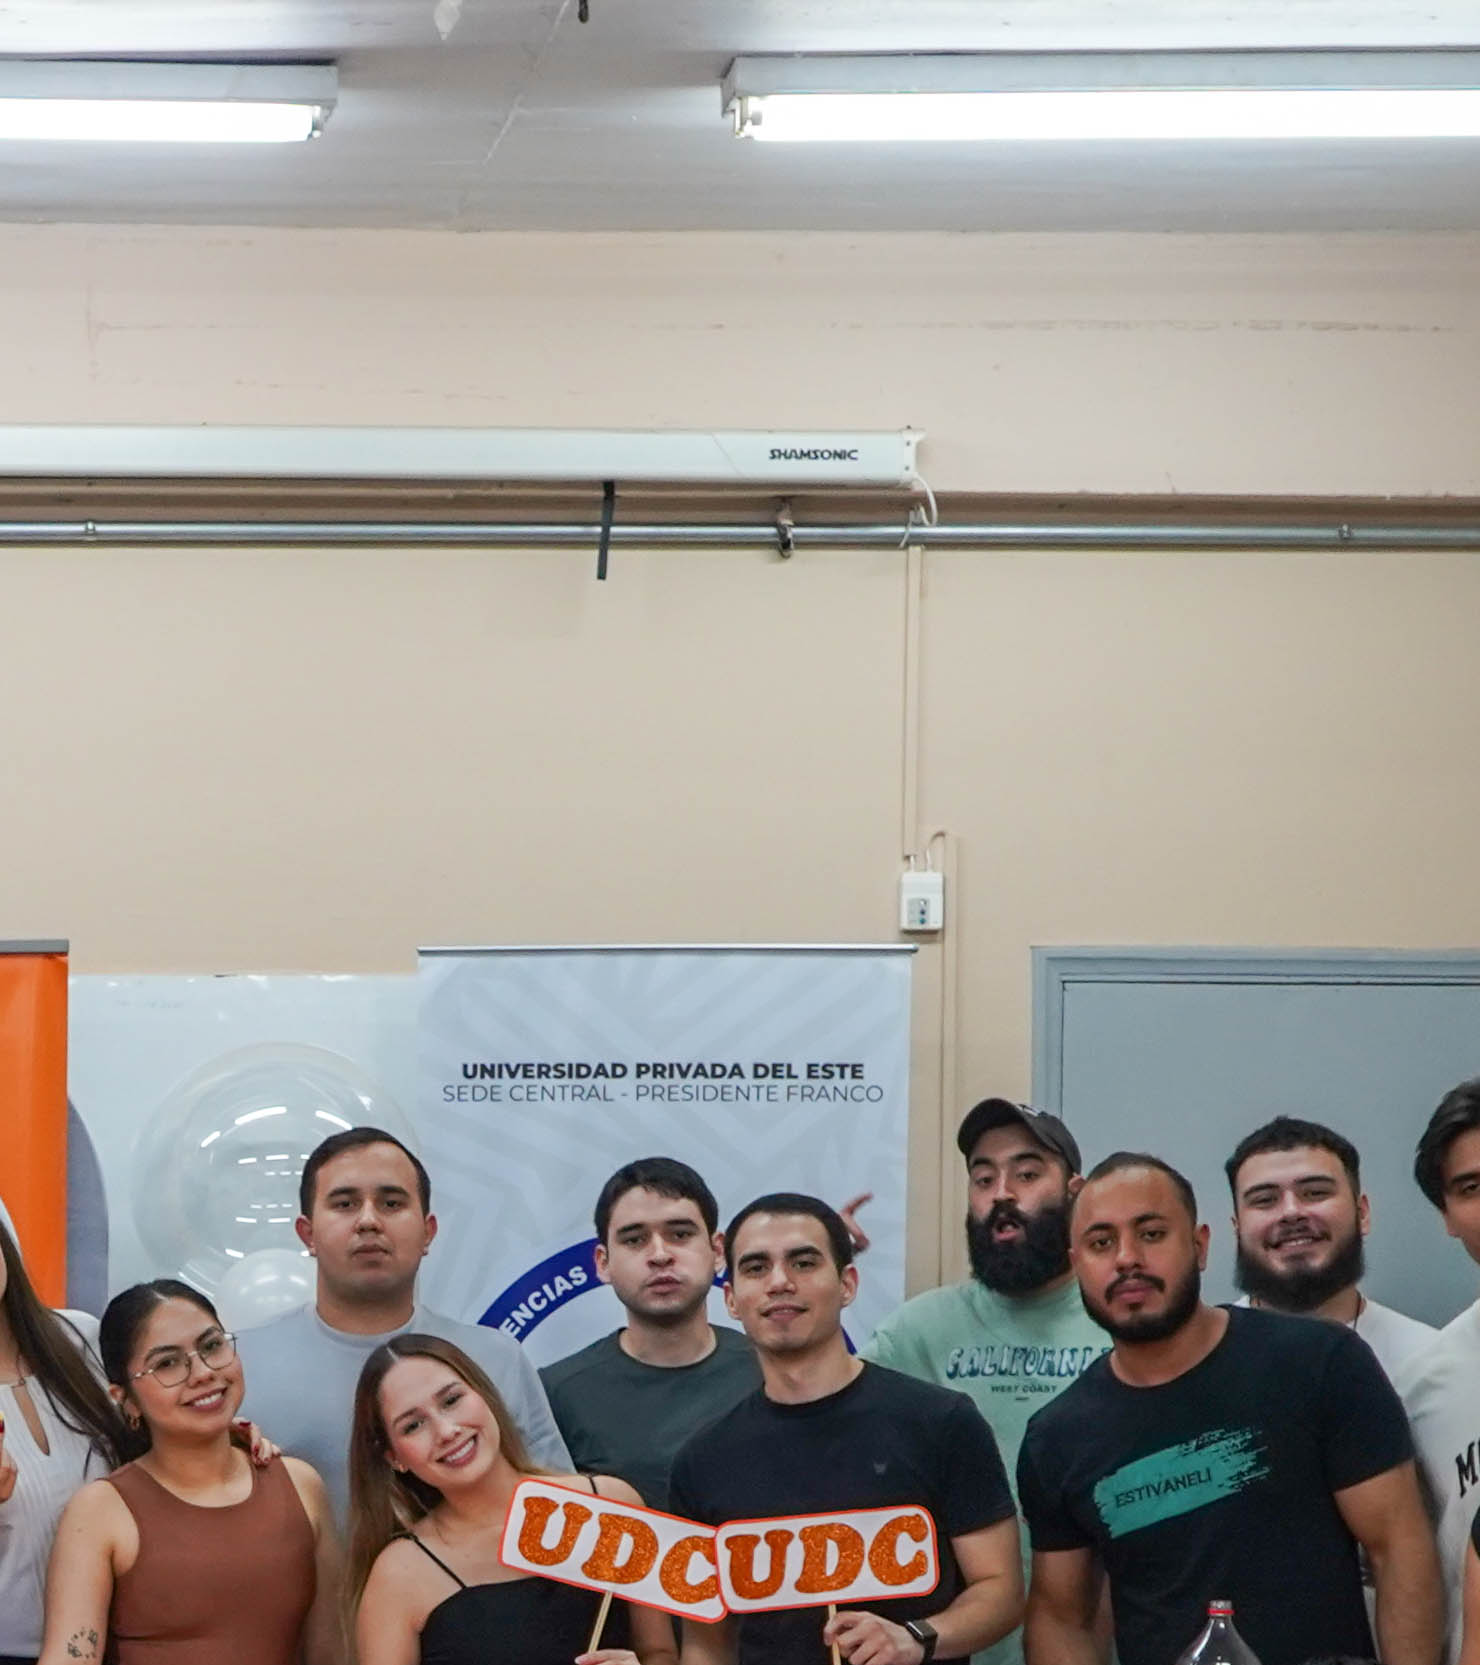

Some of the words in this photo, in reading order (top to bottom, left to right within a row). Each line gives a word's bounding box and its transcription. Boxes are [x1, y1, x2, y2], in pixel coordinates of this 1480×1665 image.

[769, 448, 858, 461] SHAMSONIC
[462, 1063, 628, 1080] UNIVERSIDAD
[635, 1063, 742, 1080] PRIVADA
[752, 1063, 799, 1080] DEL
[807, 1063, 865, 1080] ESTE
[443, 1085, 503, 1102] SEDE
[509, 1085, 614, 1102] CENTRAL
[635, 1085, 777, 1102] PRESIDENTE
[786, 1085, 884, 1102] FRANCO
[498, 1265, 589, 1338] ENCIAS
[946, 1343, 1113, 1380] CALIFORNI
[990, 1384, 1019, 1394] WEST
[1022, 1384, 1057, 1394] COAST
[1115, 1467, 1212, 1508] ESTIVANELI
[518, 1496, 718, 1604] UDC
[725, 1513, 929, 1600] UDC
